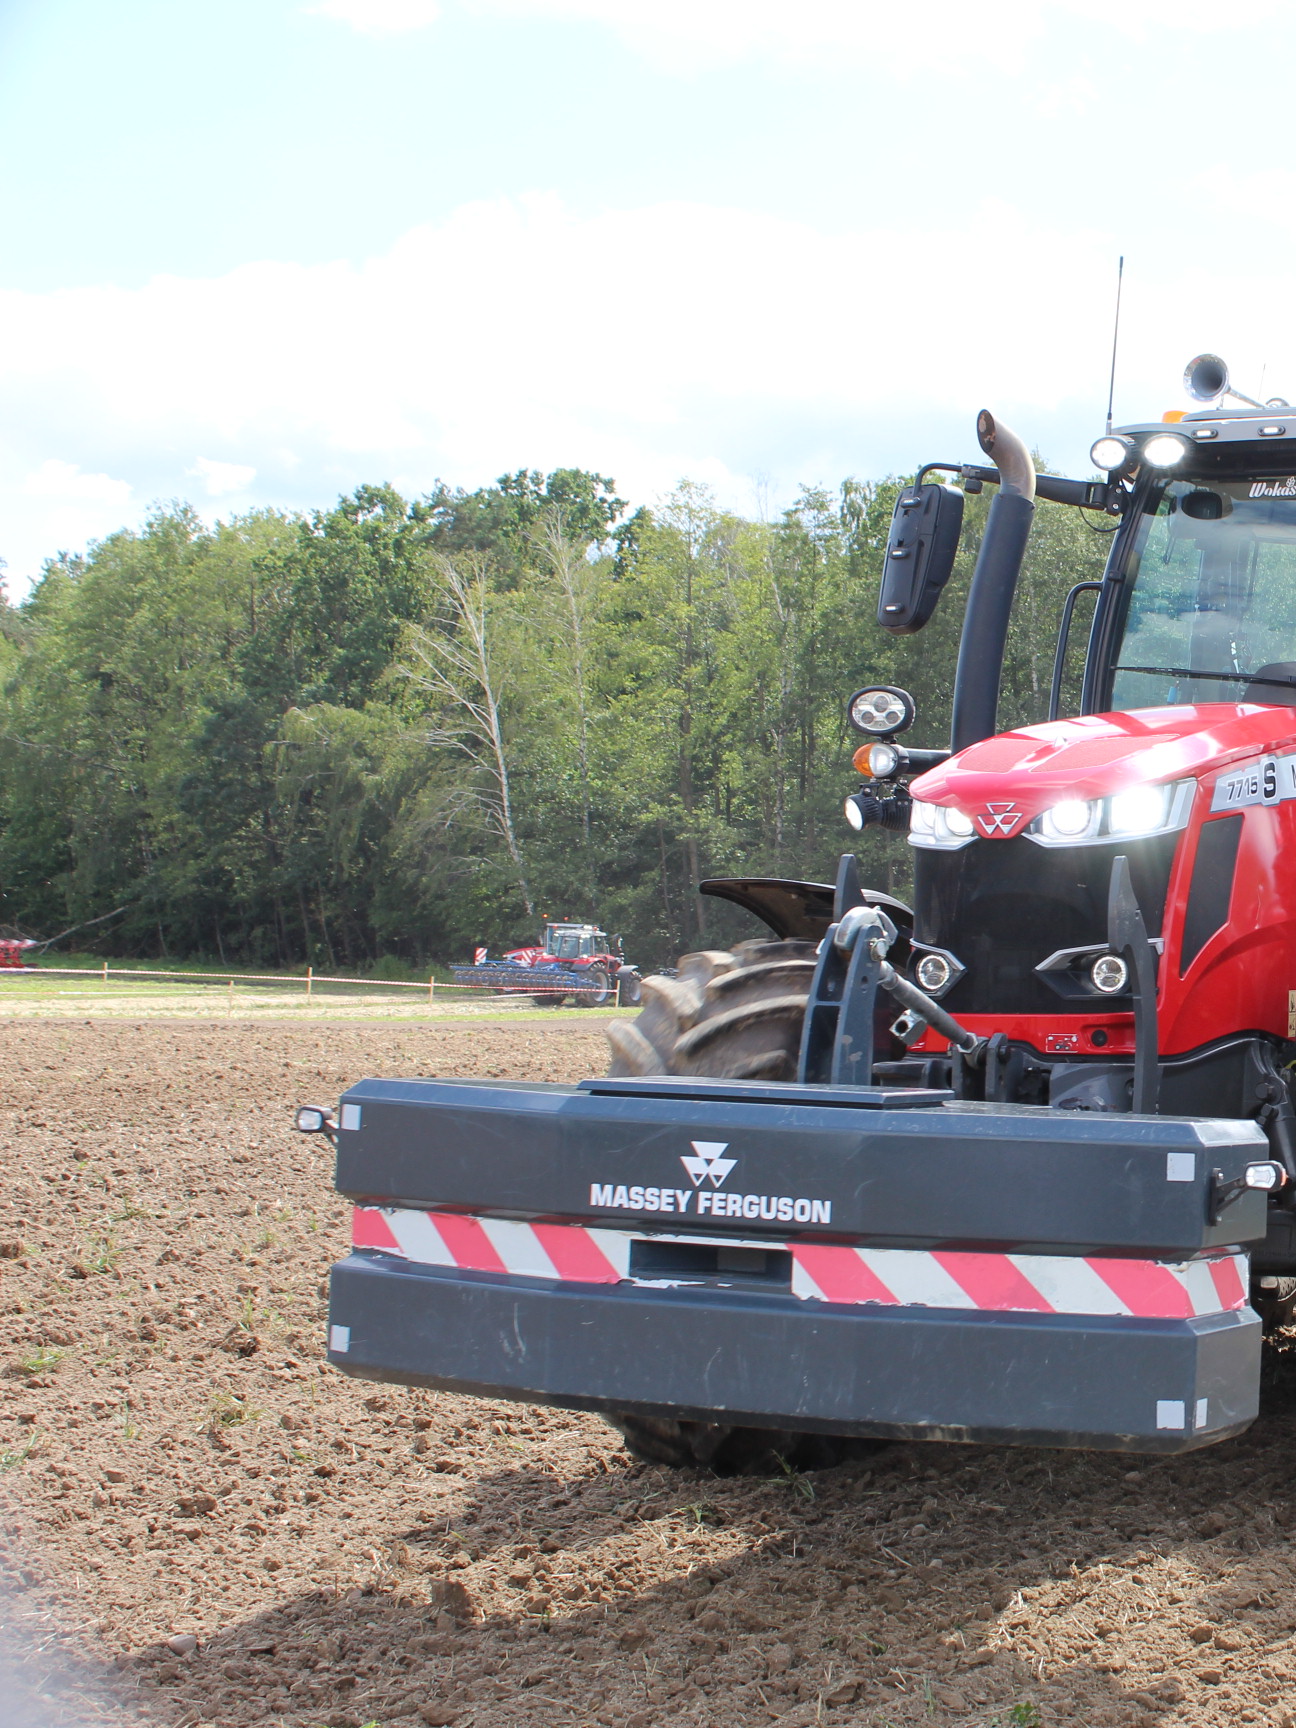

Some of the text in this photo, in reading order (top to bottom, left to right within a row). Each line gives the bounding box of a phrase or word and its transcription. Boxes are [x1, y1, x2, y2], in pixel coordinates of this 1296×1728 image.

[1226, 776, 1258, 803] 7715
[1262, 761, 1276, 799] S
[590, 1183, 832, 1224] MASSEY FERGUSON
